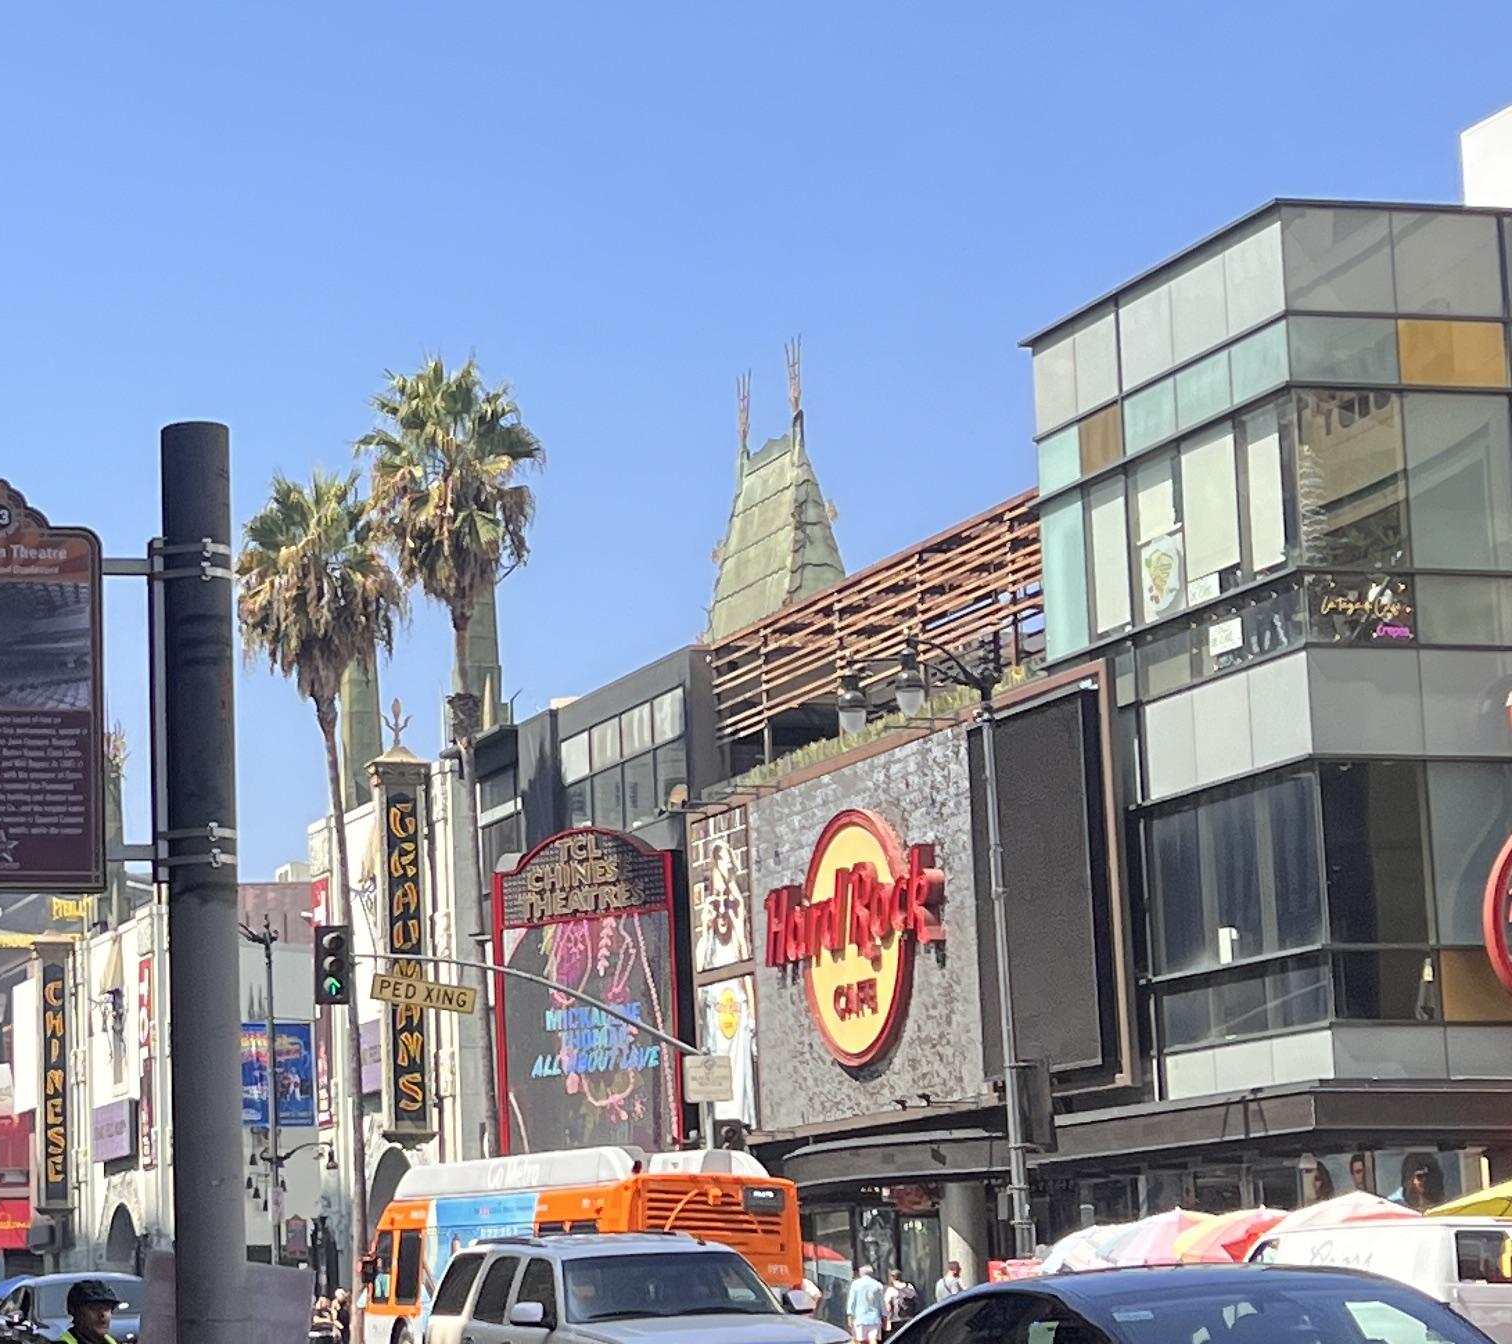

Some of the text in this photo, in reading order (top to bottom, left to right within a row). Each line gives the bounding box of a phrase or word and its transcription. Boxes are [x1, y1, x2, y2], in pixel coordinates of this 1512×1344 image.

[9, 544, 68, 560] Theatre
[556, 833, 602, 864] TCL
[520, 881, 646, 923] THEATRES
[765, 843, 946, 968] Hard Rock
[379, 980, 468, 1008] PED XING
[833, 978, 879, 1022] CAFE
[44, 979, 67, 1184] CHINESE
[531, 1054, 562, 1079] ALL
